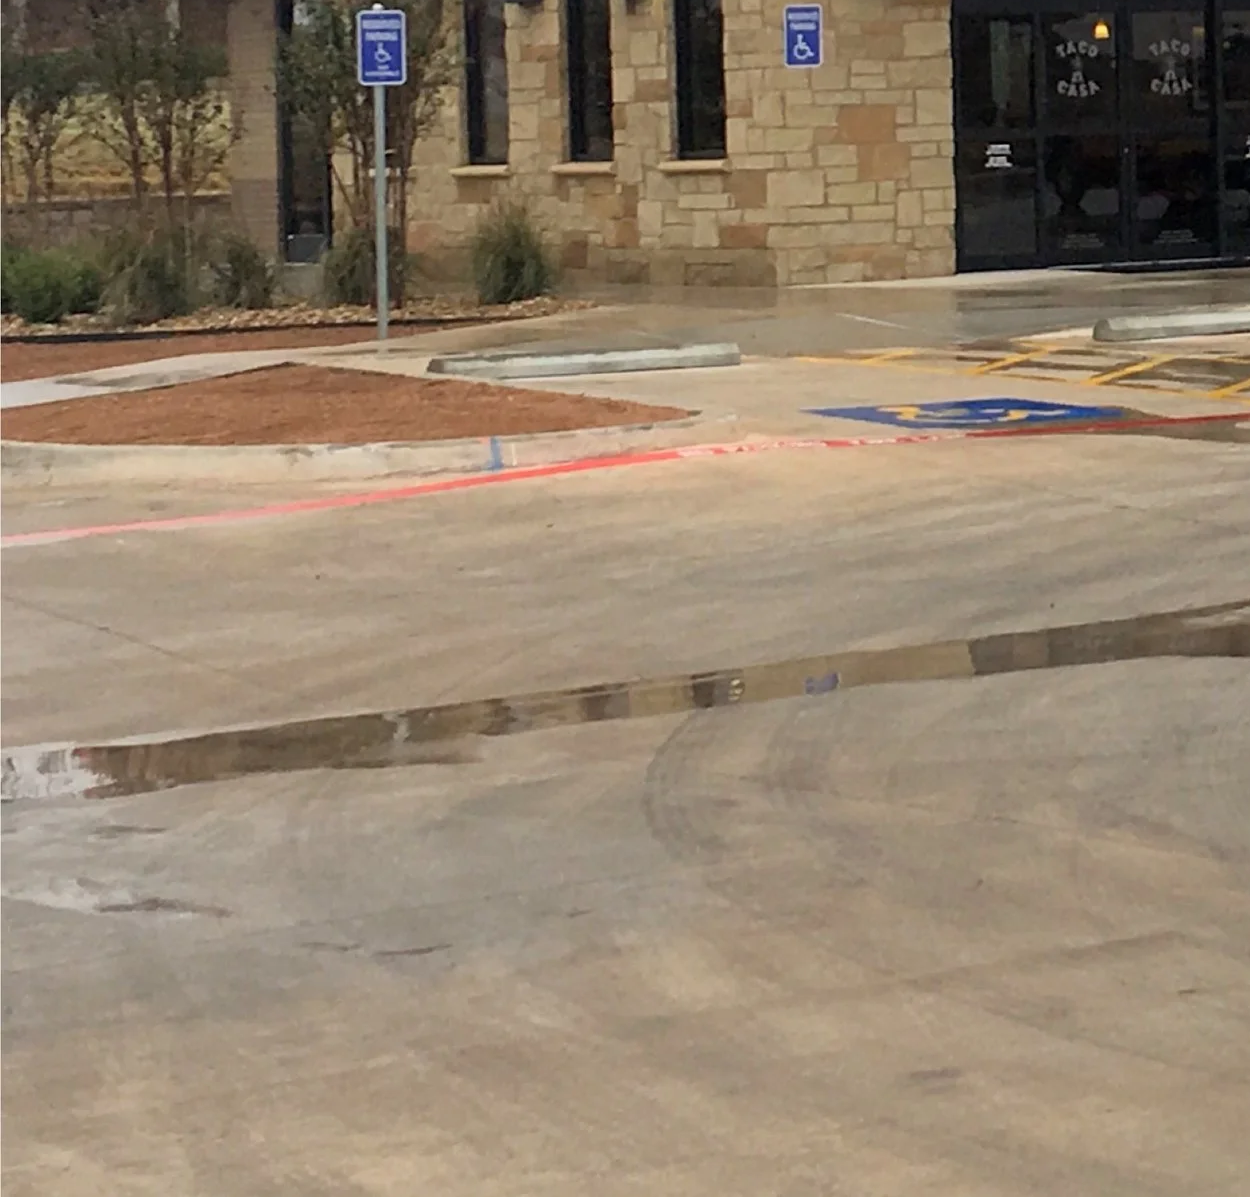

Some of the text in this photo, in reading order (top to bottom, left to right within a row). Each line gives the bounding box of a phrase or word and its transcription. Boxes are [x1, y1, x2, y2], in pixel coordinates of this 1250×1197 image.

[1055, 40, 1099, 58] TACO
[1149, 38, 1191, 57] TACO
[1057, 79, 1100, 98] CASA
[1150, 77, 1192, 96] CASA
